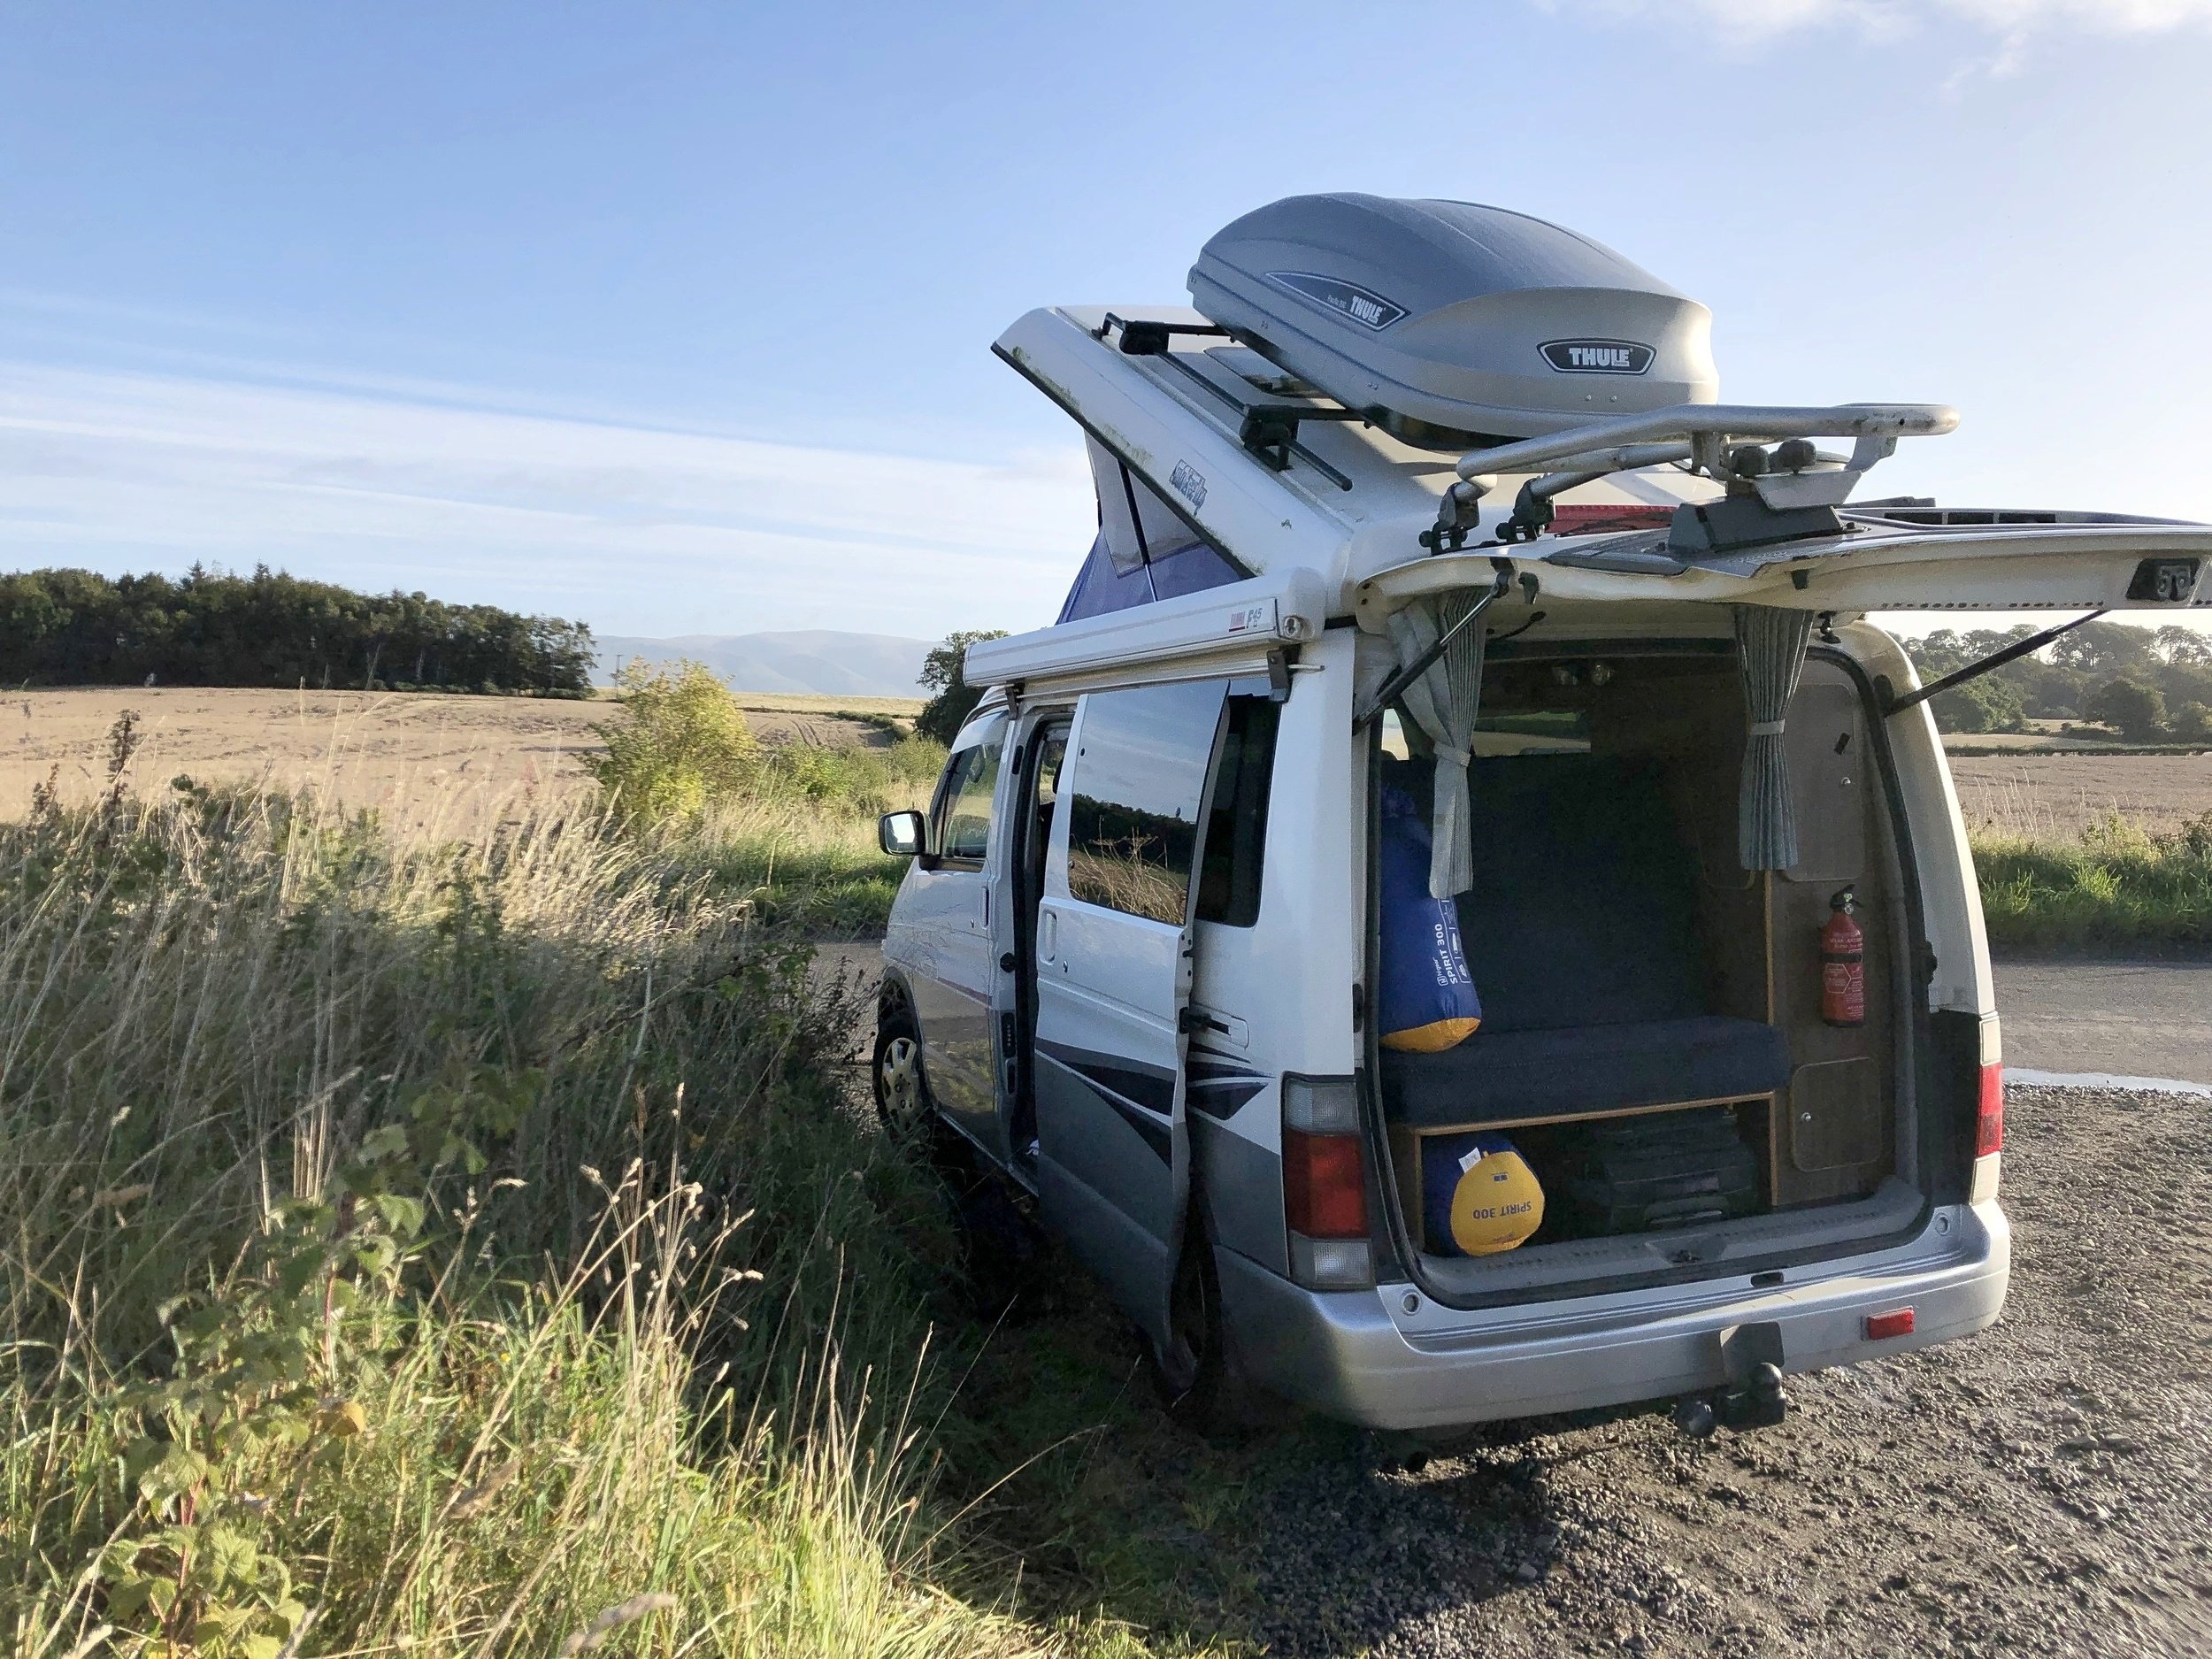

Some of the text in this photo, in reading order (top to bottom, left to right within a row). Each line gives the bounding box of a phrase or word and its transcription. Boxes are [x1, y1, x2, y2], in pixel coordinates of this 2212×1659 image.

[1350, 295, 1384, 324] THULE
[1569, 347, 1630, 367] THULE
[1434, 924, 1458, 984] SPIRIT 300
[1472, 1201, 1532, 1219] SPIRIT 300
